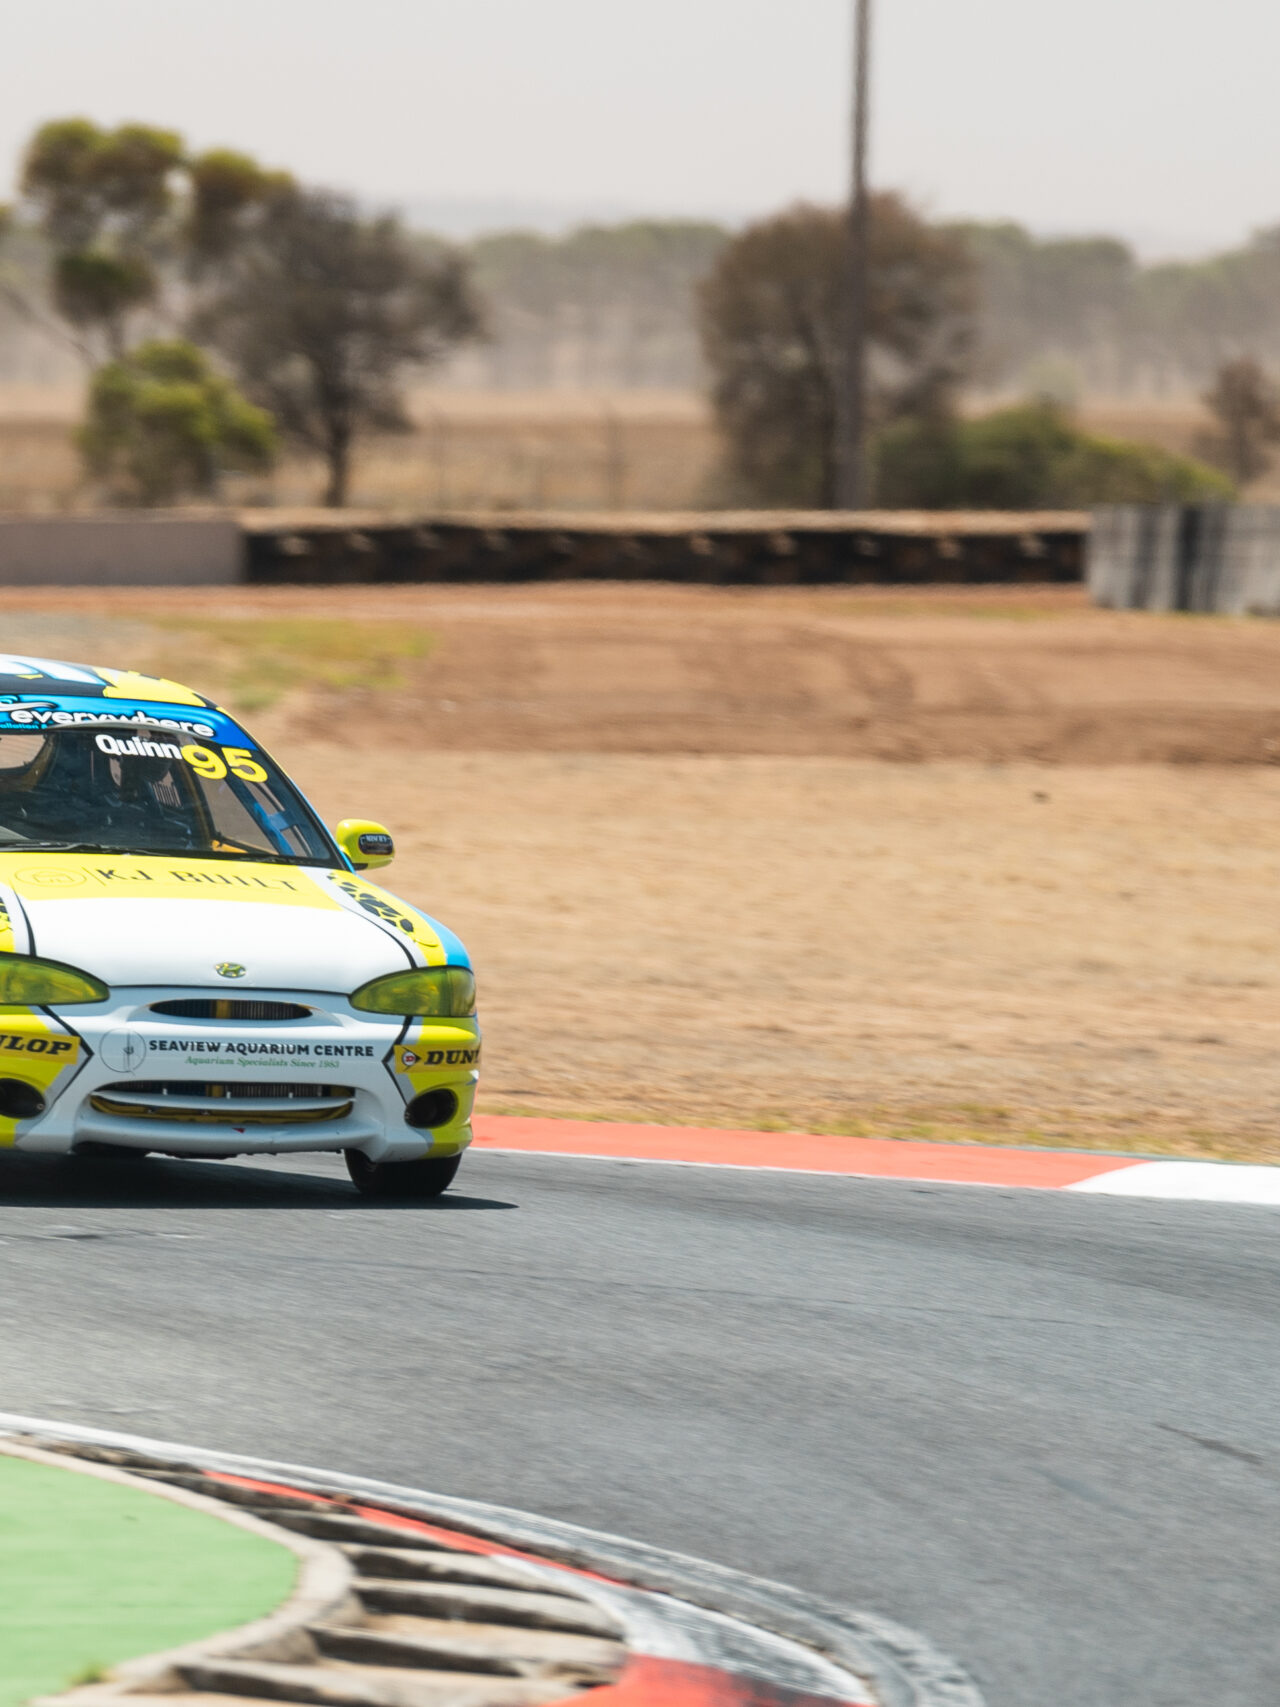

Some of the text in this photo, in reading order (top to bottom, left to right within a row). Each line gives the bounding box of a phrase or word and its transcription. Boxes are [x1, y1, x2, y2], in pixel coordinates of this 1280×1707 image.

[94, 734, 269, 784] Quinn 95
[148, 1040, 375, 1058] SEAVIEW AQUARIUM CENTRE
[423, 1047, 480, 1066] DUN
